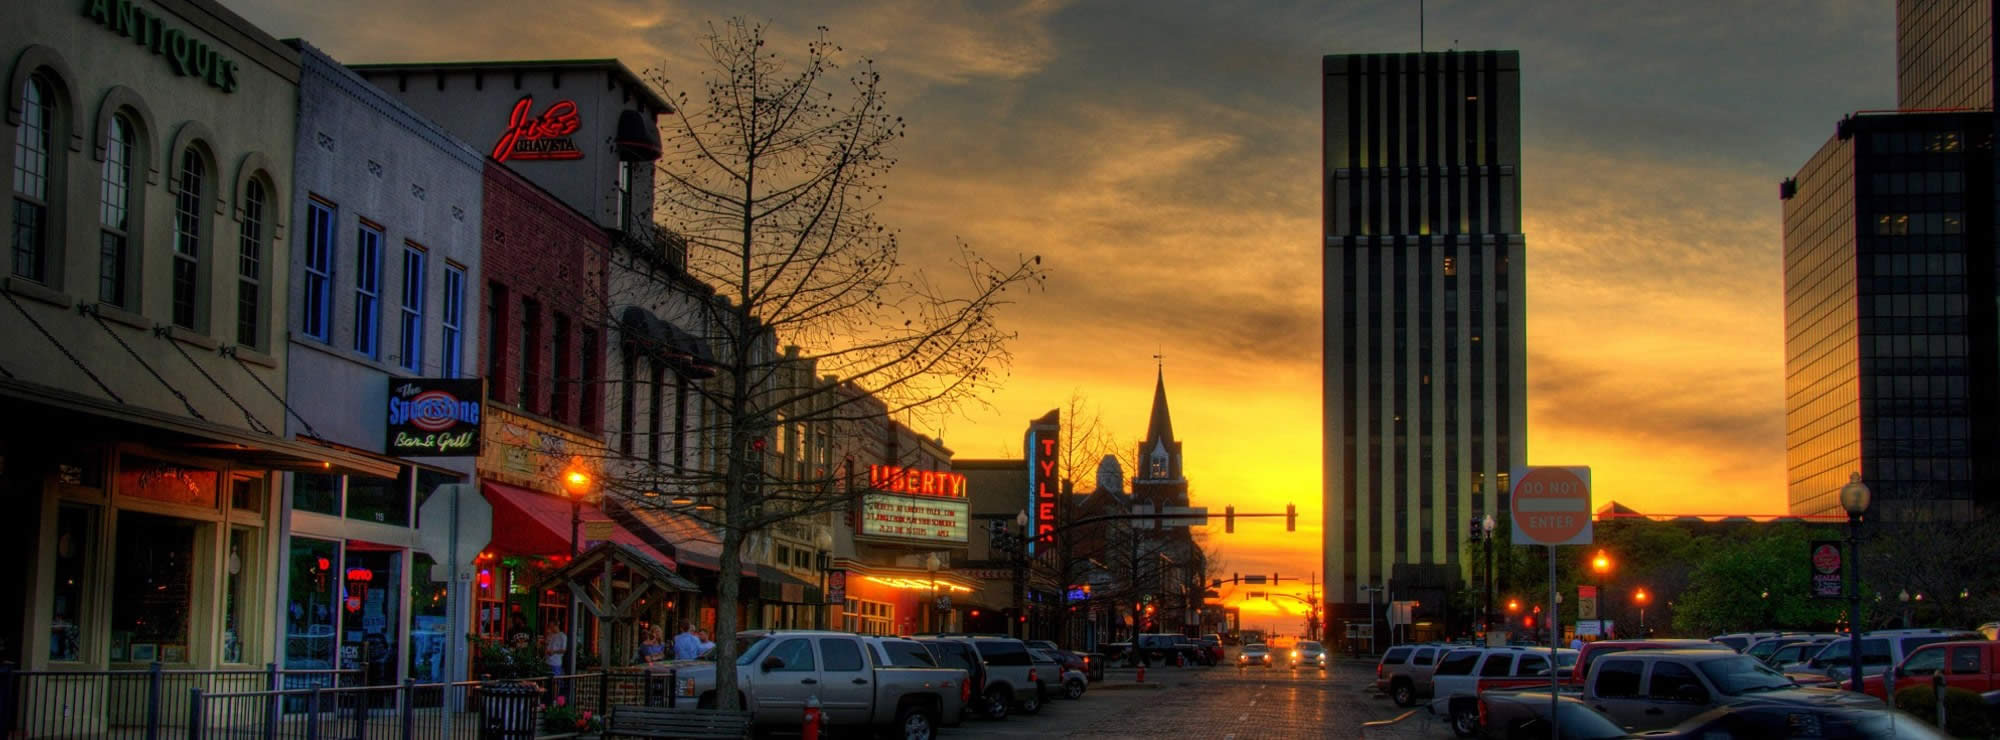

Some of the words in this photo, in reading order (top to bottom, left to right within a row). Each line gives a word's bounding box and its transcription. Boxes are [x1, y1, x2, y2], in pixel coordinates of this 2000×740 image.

[84, 0, 239, 93] ANTIQUES
[396, 383, 422, 397] The
[394, 432, 425, 447] Bar
[425, 434, 436, 447] &
[437, 432, 473, 453] Grill
[869, 464, 964, 498] LIBERTY
[1040, 439, 1055, 542] TYLER
[1523, 481, 1544, 495] DO
[1549, 481, 1577, 495] NOT
[1528, 515, 1574, 529] ENTER
